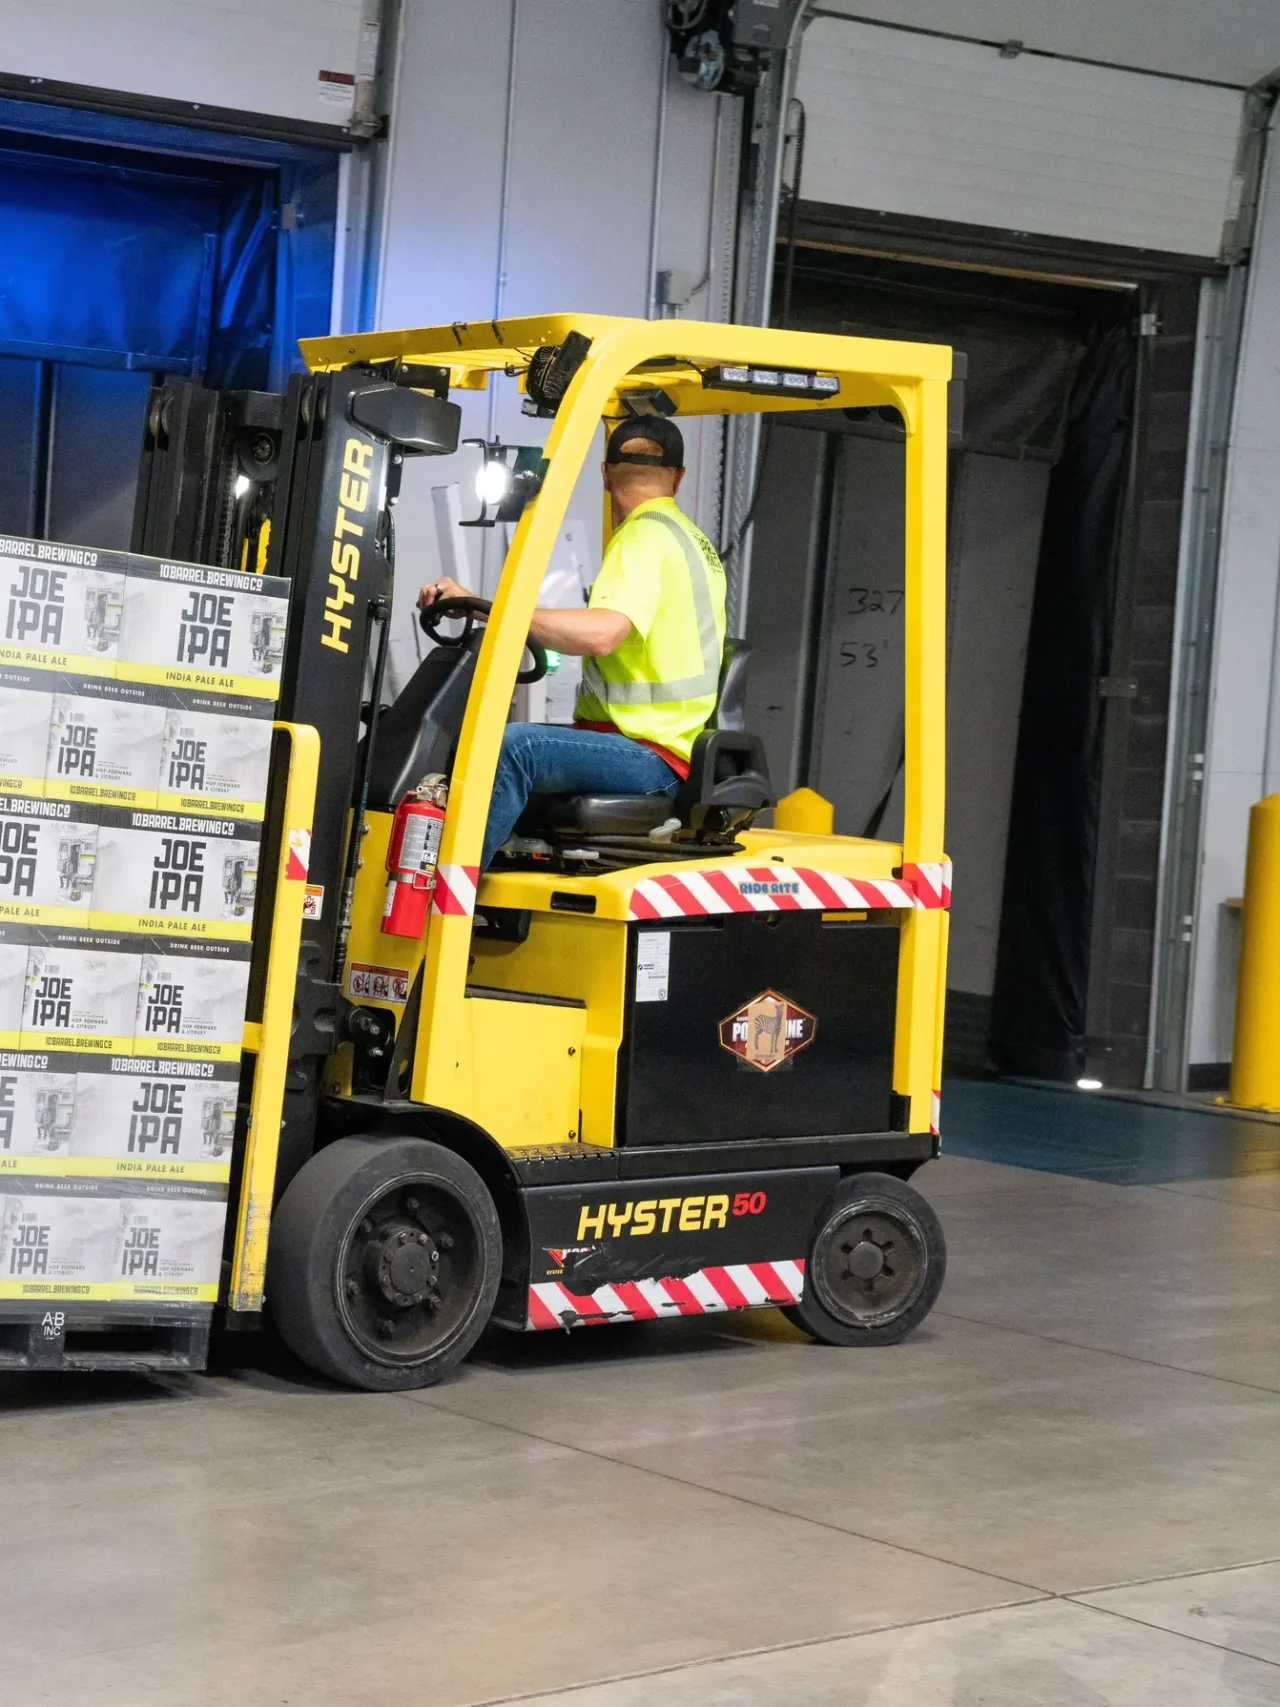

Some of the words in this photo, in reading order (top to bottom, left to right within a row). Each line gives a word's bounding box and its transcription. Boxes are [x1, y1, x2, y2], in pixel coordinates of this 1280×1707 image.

[321, 438, 374, 654] HYSTER
[10, 565, 68, 604] JOE
[181, 591, 235, 628] JOE
[847, 588, 904, 615] 327
[5, 598, 64, 645] IPA
[176, 623, 232, 668] IPA
[26, 652, 47, 664] PALE
[51, 656, 67, 666] ALE
[4, 674, 31, 683] OUTSIDE
[83, 683, 102, 691] DRINK
[120, 688, 145, 697] OUTSIDE
[166, 671, 192, 683] INDIA
[195, 675, 216, 686] PALE
[218, 679, 234, 688] ALE
[192, 698, 211, 706] DRINK
[228, 703, 253, 711] OUTSIDE
[60, 724, 98, 749] JOE
[57, 746, 96, 777] IPA
[171, 739, 207, 763] JOE
[168, 761, 205, 790] IPA
[153, 838, 207, 873] JOE
[149, 870, 204, 913] IPA
[771, 883, 799, 894] RITE
[24, 908, 40, 917] ALE
[138, 919, 164, 929] INDIA
[168, 922, 188, 931] PALE
[191, 924, 206, 932] ALE
[57, 934, 77, 942] DRINK
[170, 942, 188, 950] DRINK
[205, 945, 230, 953] OUTSIDE
[35, 976, 73, 1000] JOE
[148, 983, 184, 1006] JOE
[32, 999, 71, 1028] IPA
[145, 1005, 182, 1033] IPA
[132, 1082, 186, 1115] JOE
[127, 1114, 183, 1155] IPA
[1, 1159, 18, 1168] ALE
[116, 1163, 143, 1172] INDIA
[146, 1164, 167, 1173] PALE
[169, 1165, 185, 1173] ALE
[576, 1194, 729, 1241] HYSTER
[732, 1191, 766, 1216] 50
[12, 1225, 51, 1247] JOE
[124, 1227, 161, 1249] JOE
[9, 1247, 49, 1275] IPA
[121, 1249, 159, 1276] IPA
[43, 1325, 61, 1336] INC
